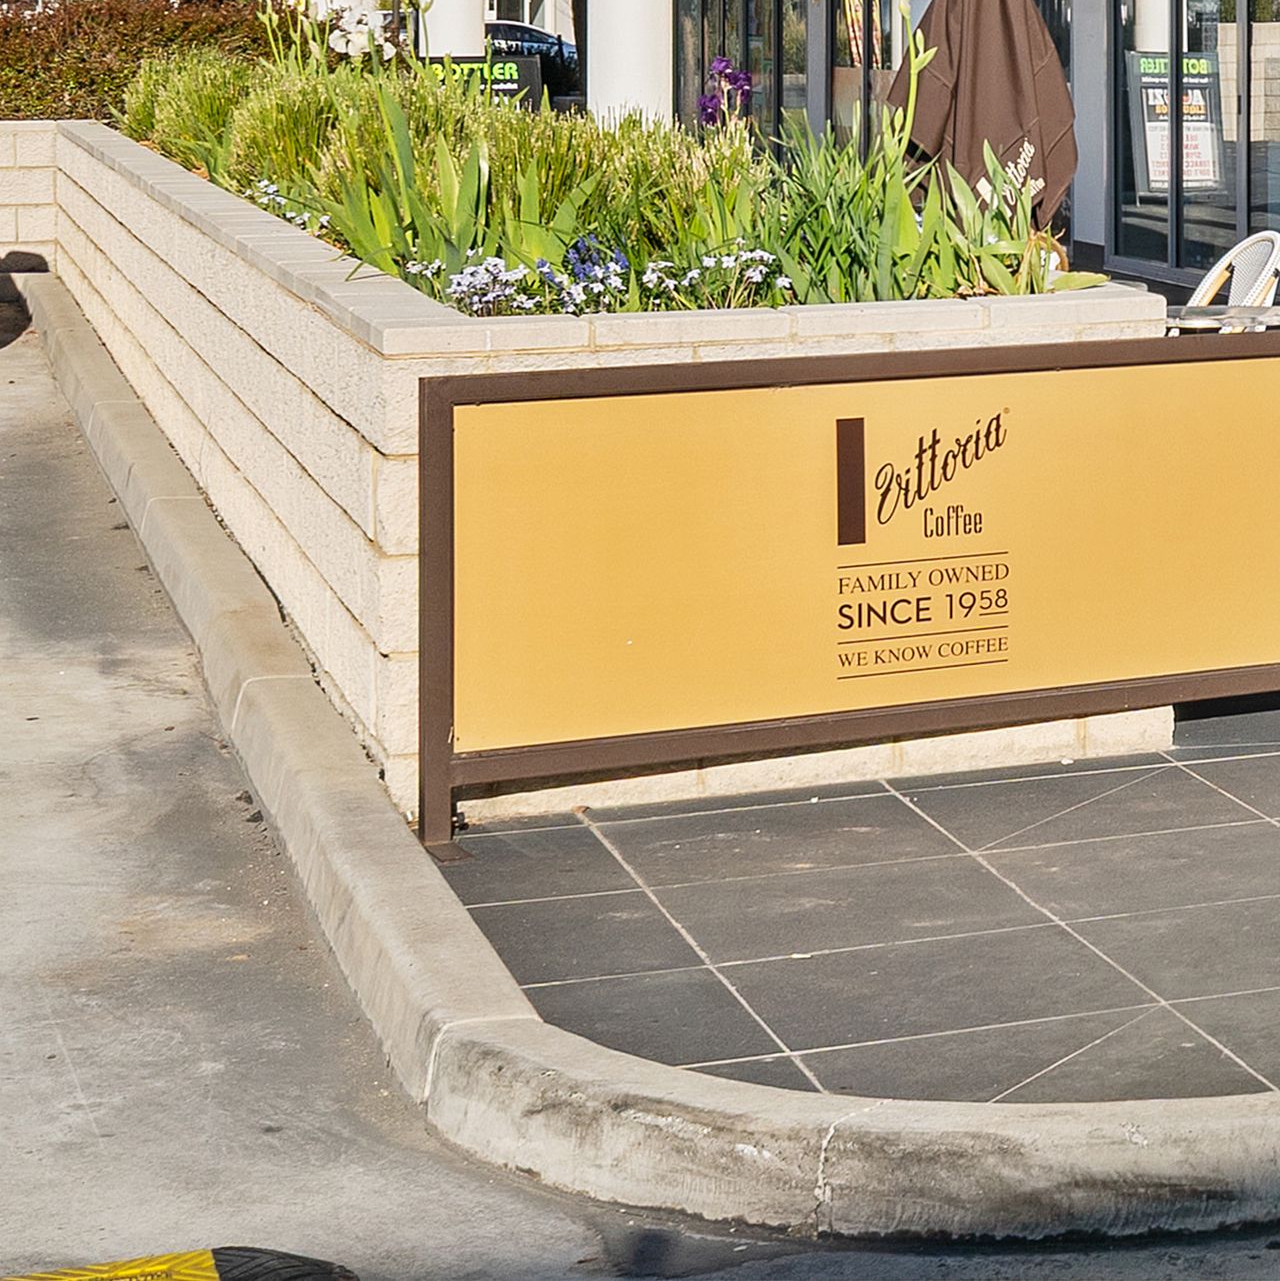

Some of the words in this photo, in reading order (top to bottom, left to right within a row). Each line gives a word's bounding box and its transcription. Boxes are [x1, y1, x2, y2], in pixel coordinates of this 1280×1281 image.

[874, 412, 1008, 526] Vittoria
[923, 504, 983, 539] Coffee
[838, 571, 922, 595] FAMILY
[928, 563, 1010, 587] OWNED
[837, 597, 933, 630] SINCE
[945, 588, 1009, 620] 1958
[838, 651, 868, 668] WE
[873, 644, 933, 666] KNOW
[937, 636, 1009, 659] COFFEE
